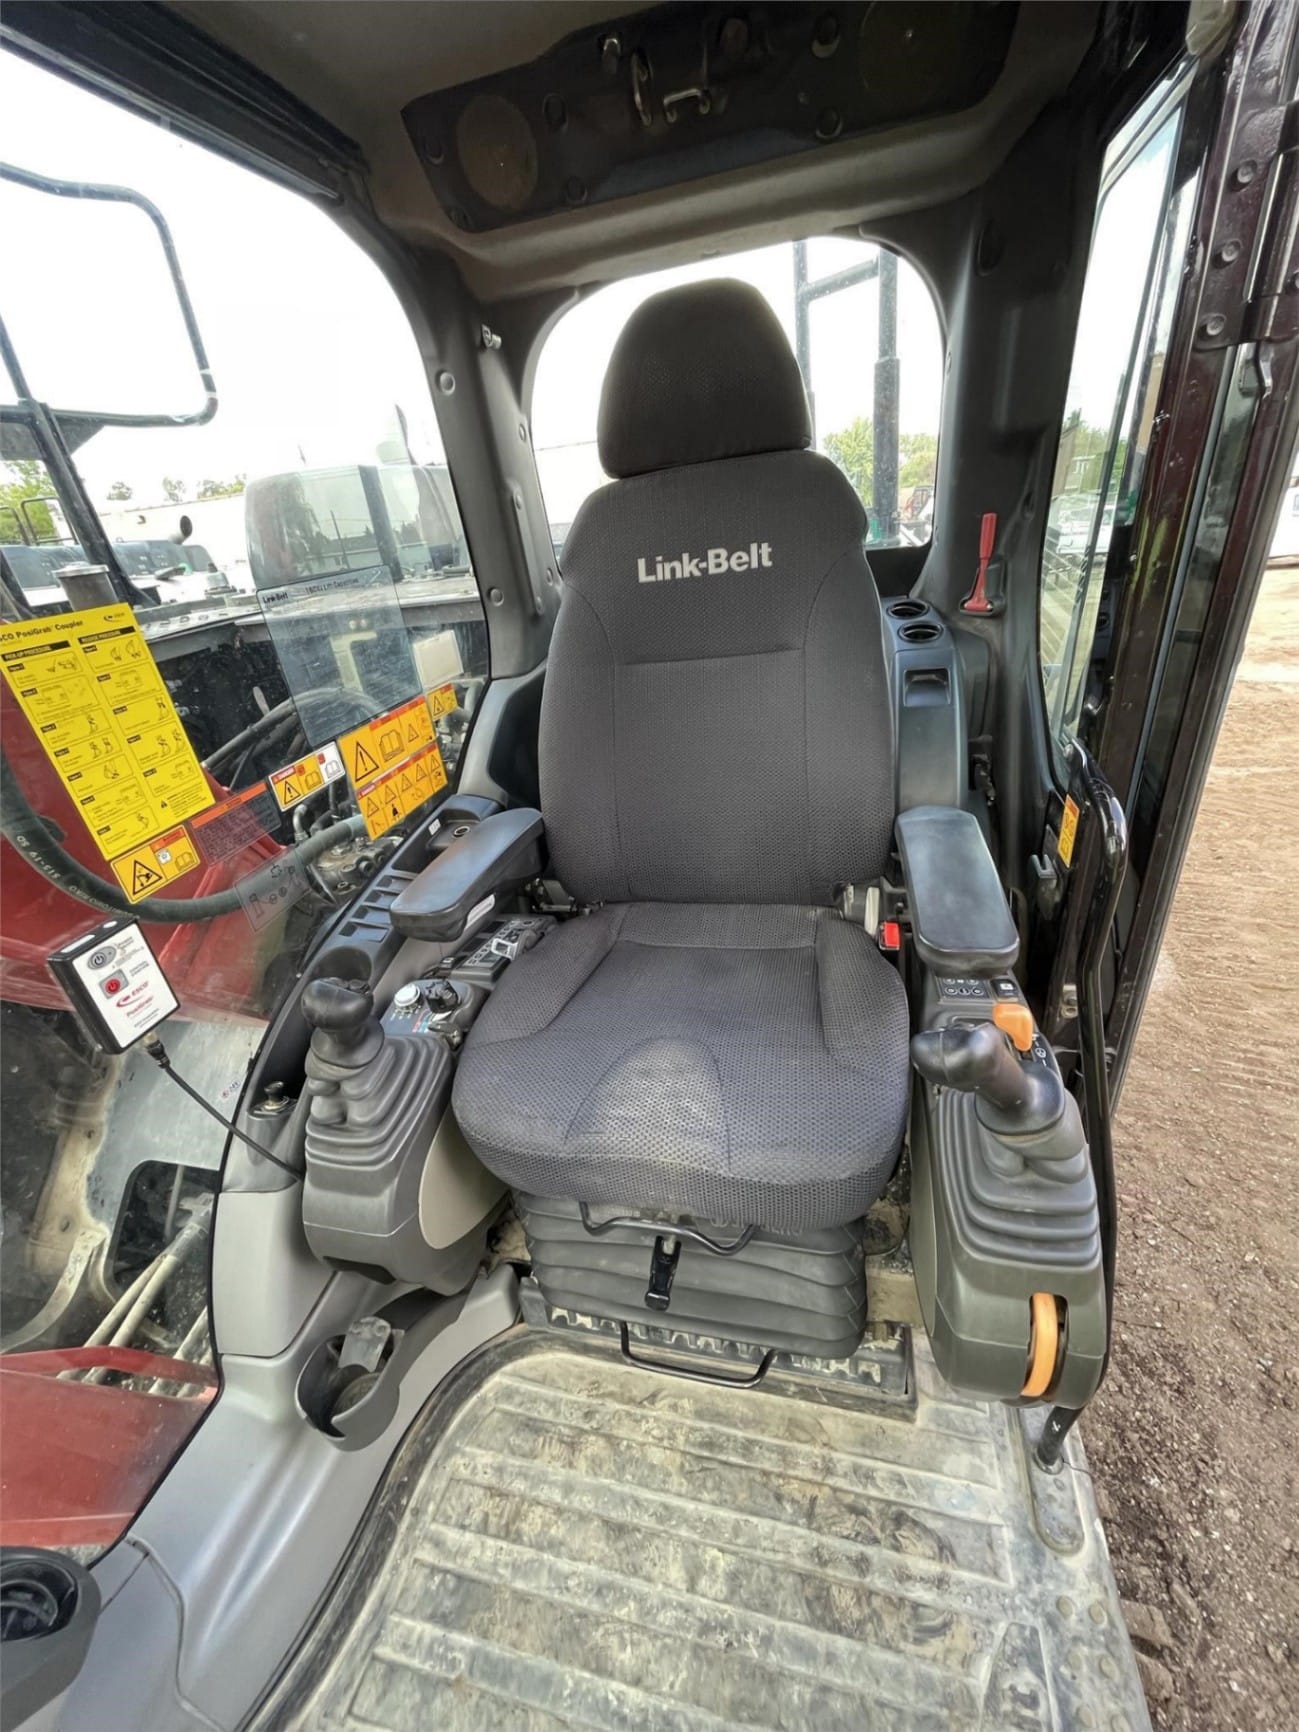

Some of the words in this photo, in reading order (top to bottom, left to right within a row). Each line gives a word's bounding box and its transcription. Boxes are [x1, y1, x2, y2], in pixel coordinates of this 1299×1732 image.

[637, 542, 773, 583] Link-Belt
[0, 633, 15, 642] CO
[55, 619, 84, 632] Coupler
